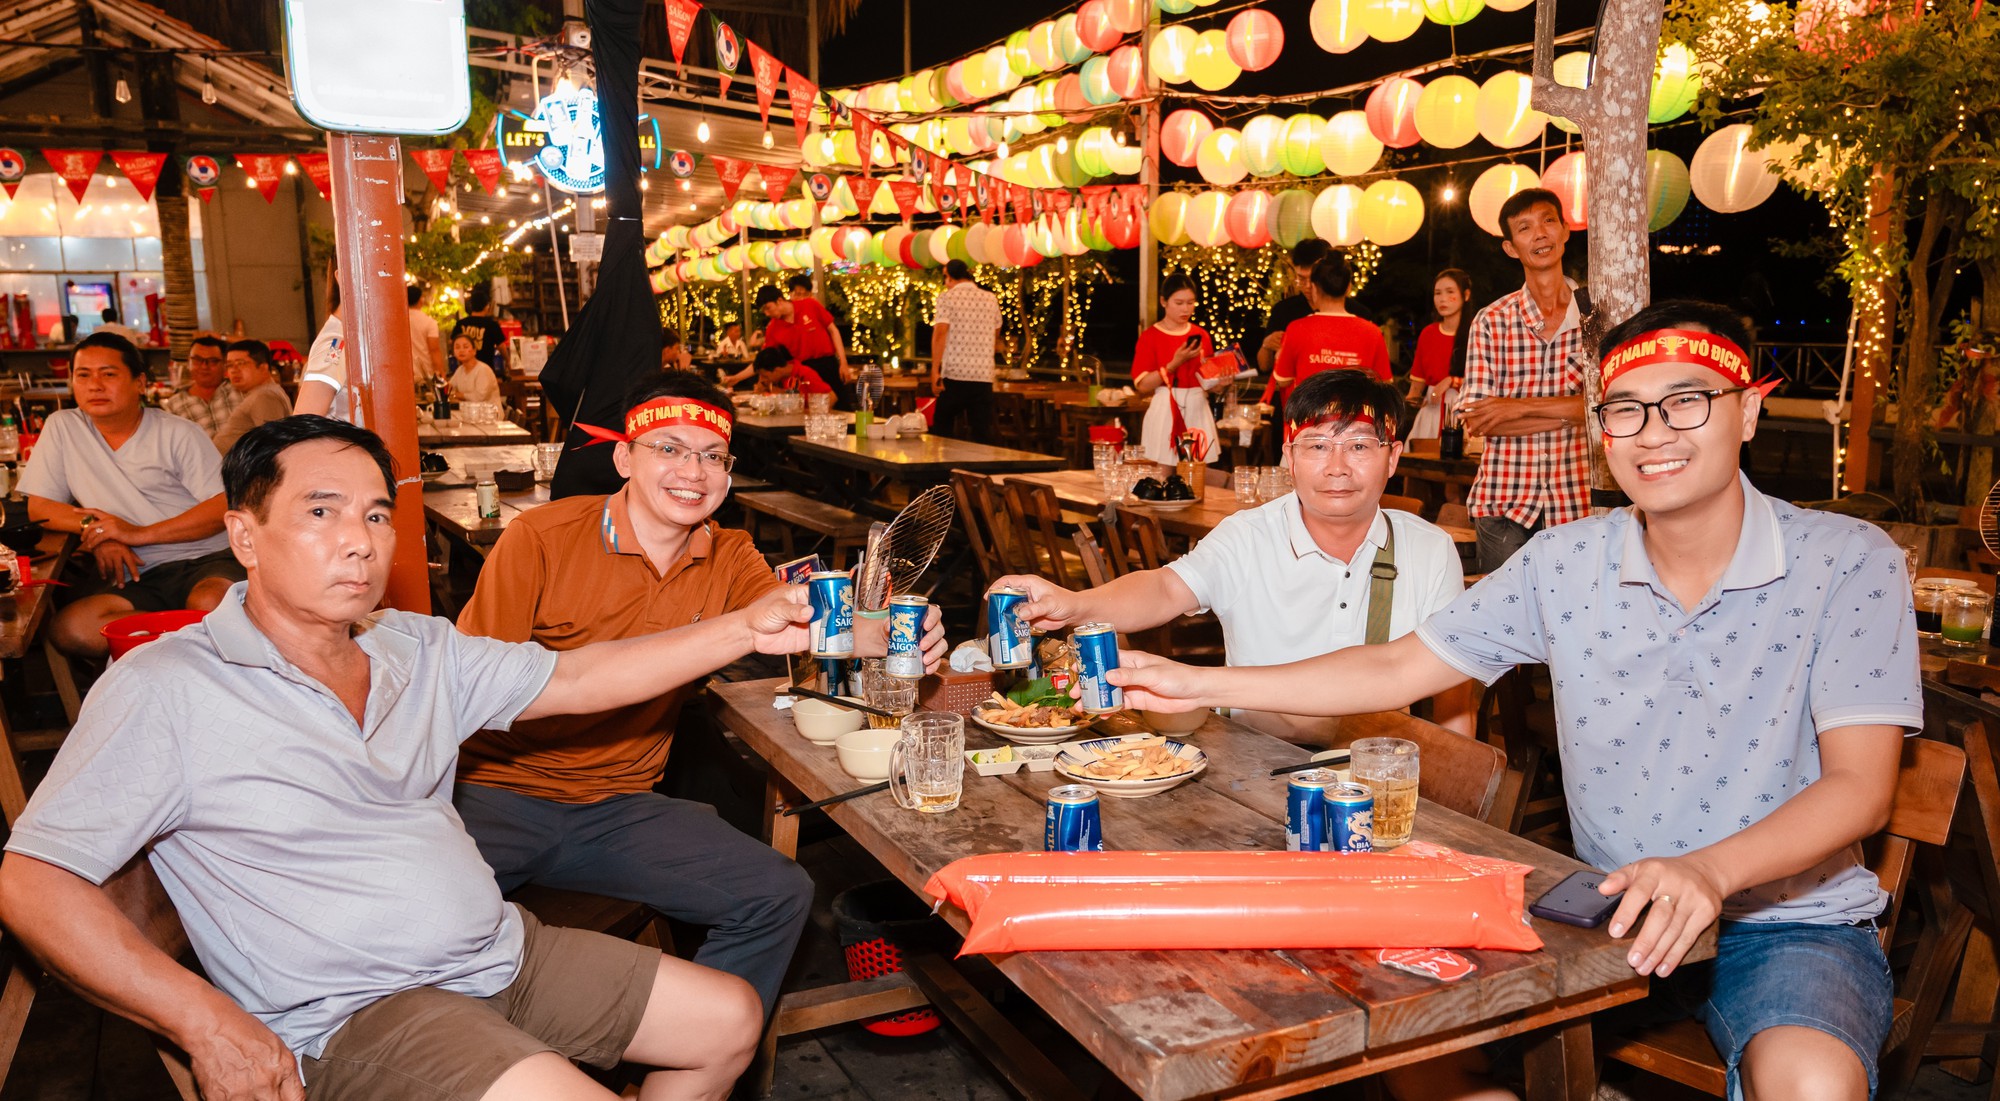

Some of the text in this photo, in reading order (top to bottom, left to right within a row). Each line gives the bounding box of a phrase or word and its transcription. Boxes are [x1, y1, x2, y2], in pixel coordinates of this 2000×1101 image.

[669, 5, 691, 22] SAIGON
[506, 132, 545, 147] LET'S
[1309, 354, 1344, 365] SAIGON
[1621, 339, 1657, 365] NAM
[1688, 339, 1710, 357] VÔ
[1711, 344, 1742, 373] ĐỊCH
[636, 408, 655, 426] VIỆT
[655, 405, 683, 420] NAM
[703, 409, 717, 424] VÔ
[835, 617, 853, 627] SAIG
[1356, 841, 1370, 849] BIA
